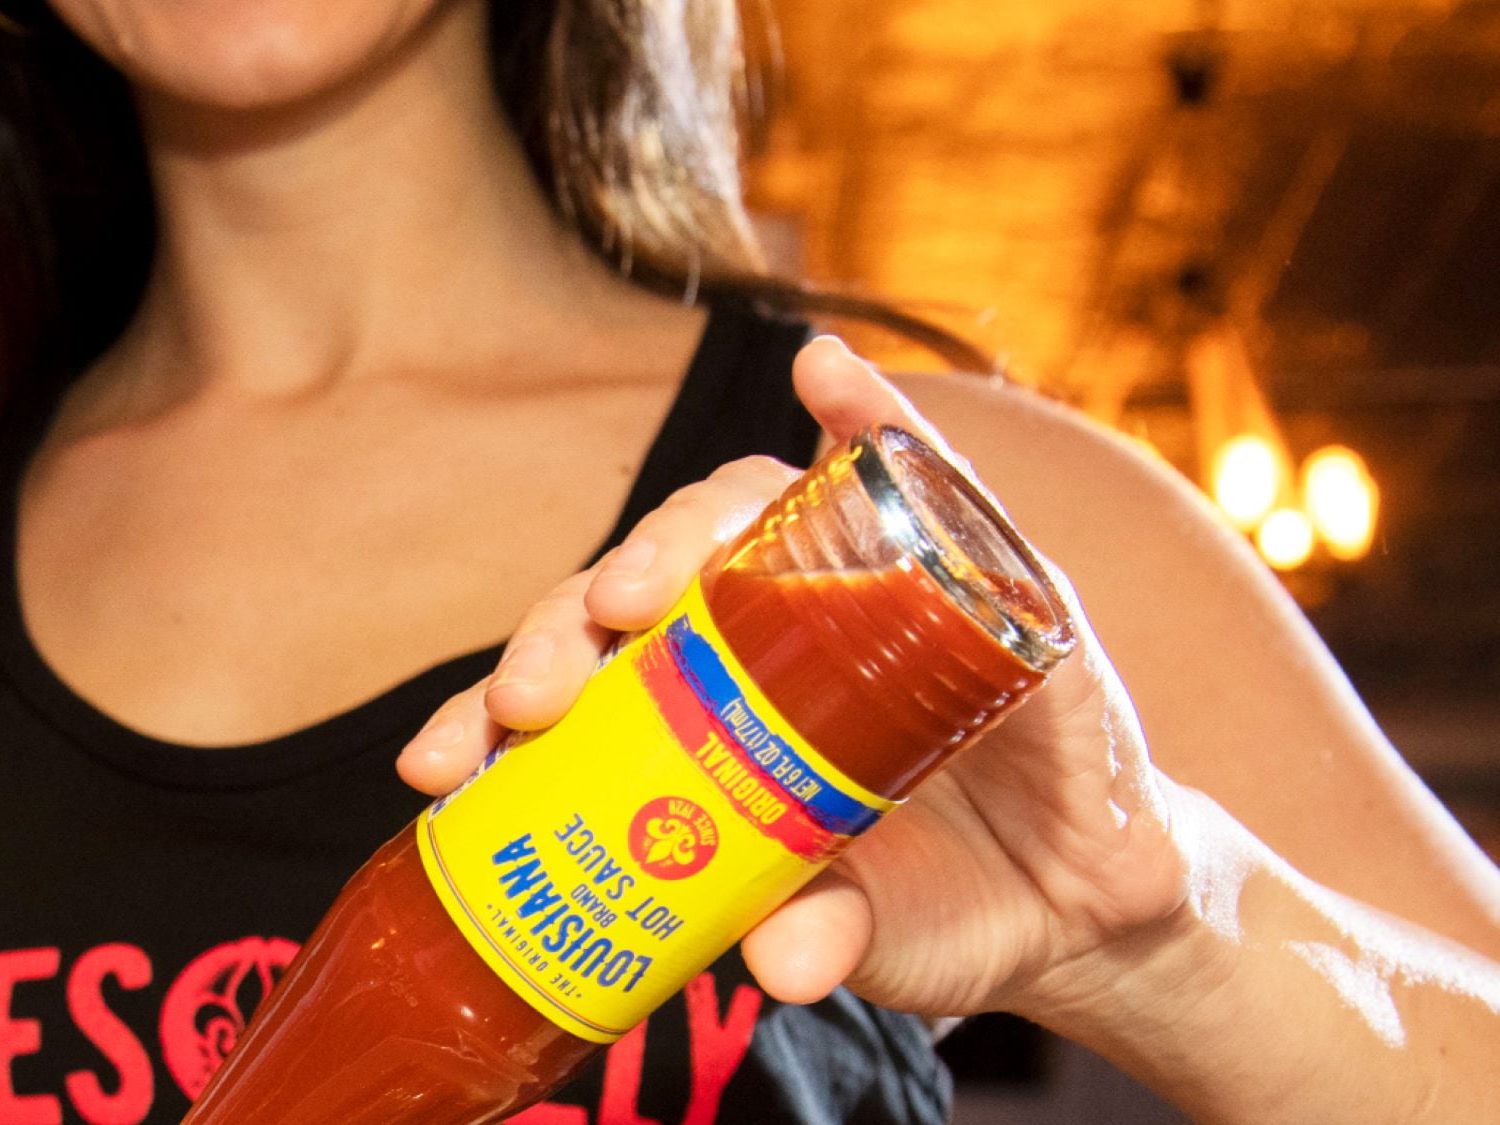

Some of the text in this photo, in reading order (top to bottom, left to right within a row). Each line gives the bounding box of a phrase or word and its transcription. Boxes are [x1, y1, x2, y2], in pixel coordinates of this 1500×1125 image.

[754, 740, 781, 765] OZ
[695, 731, 788, 825] ORIGINAL
[784, 768, 803, 786] 6
[788, 775, 822, 802] NET
[693, 814, 716, 846] SINCE
[553, 813, 685, 941] HOT SAUCE
[492, 832, 654, 993] LOUISIANA
[570, 883, 619, 928] BRAND
[491, 909, 578, 997] THE ORIGINAL
